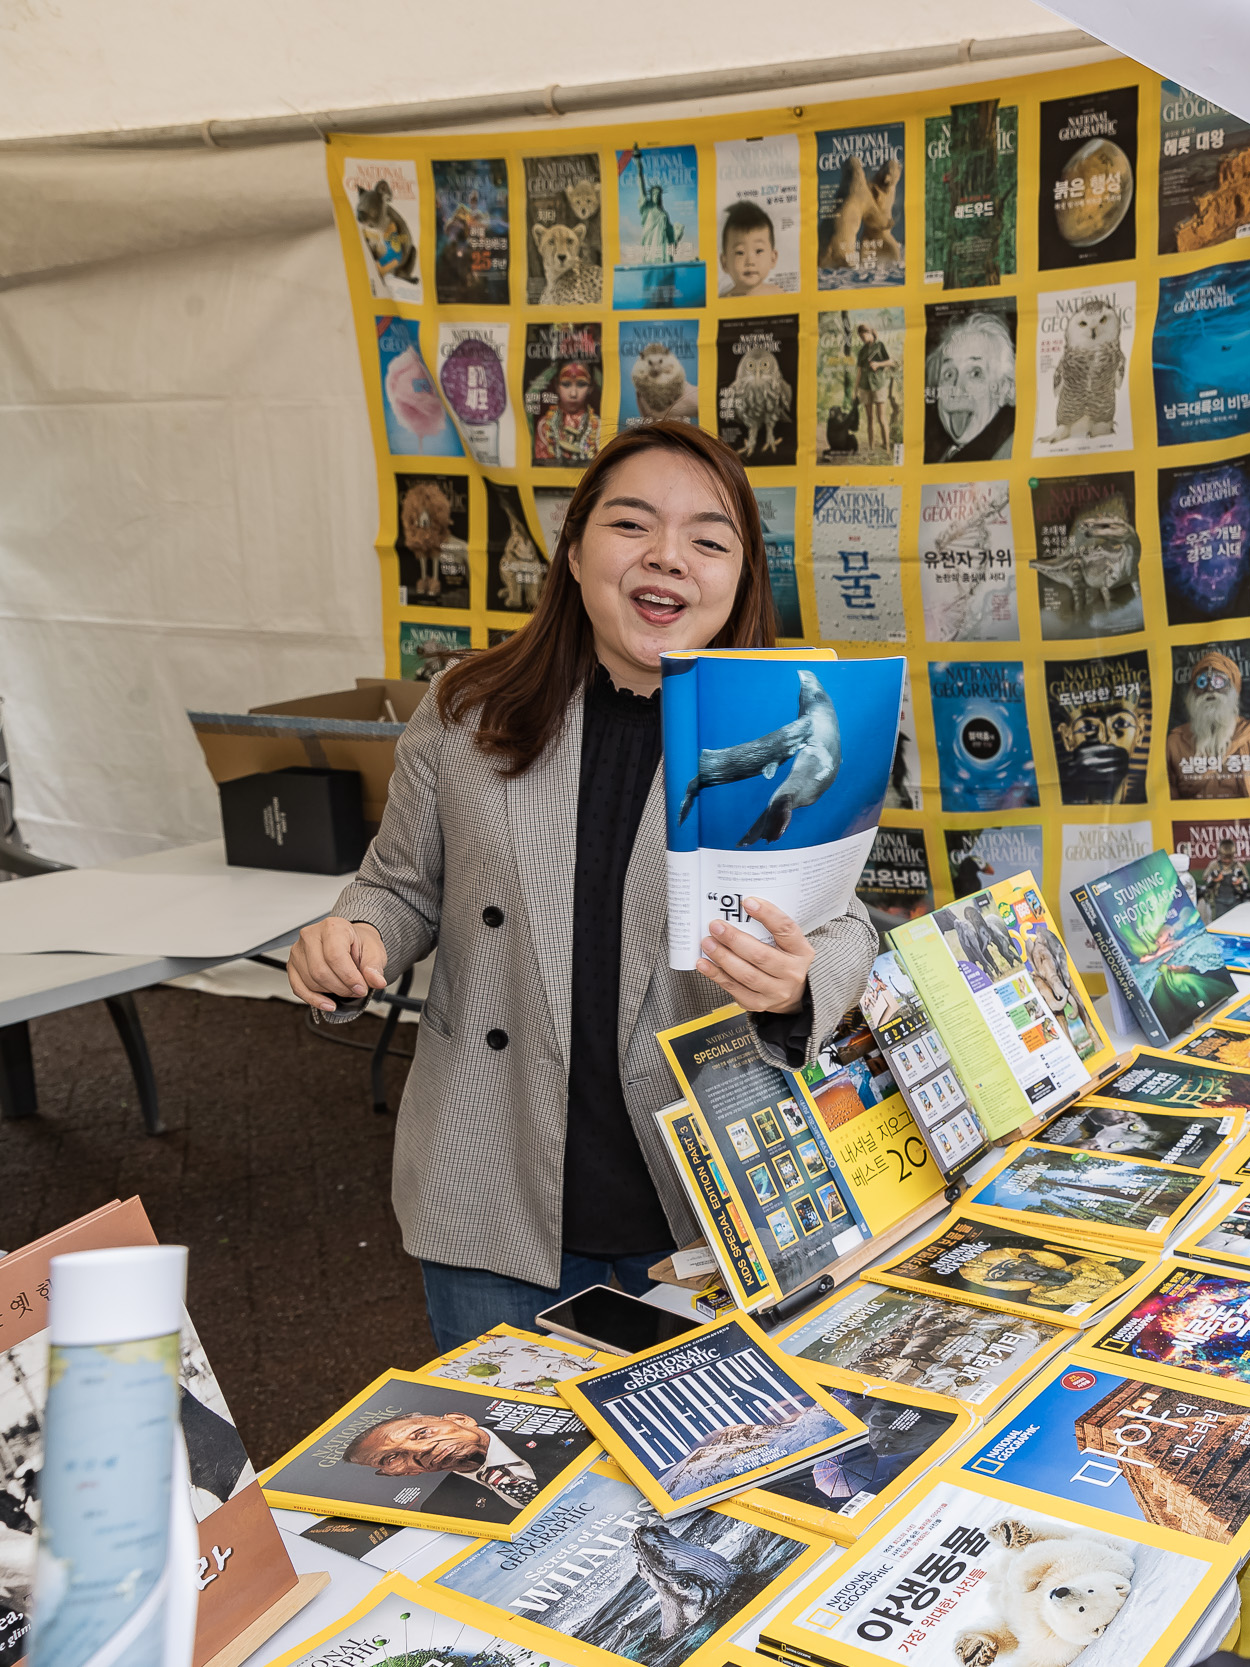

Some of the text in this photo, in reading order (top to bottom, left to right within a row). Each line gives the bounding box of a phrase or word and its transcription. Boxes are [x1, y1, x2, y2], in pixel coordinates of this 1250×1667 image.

[1058, 119, 1118, 142] GEOGRAPHIC
[1068, 111, 1108, 128] NATIONAL
[832, 132, 890, 154] NATIONAL
[1164, 136, 1190, 156] 헤롯
[1196, 128, 1224, 150] 대왕
[1053, 172, 1122, 200] 붉은 행성
[954, 200, 994, 220] 레드우드
[1174, 294, 1238, 314] GEOGRAPHIC
[1184, 284, 1227, 300] NATIONAL
[632, 326, 684, 340] NATIONAL
[1164, 396, 1224, 420] 남극대륙의
[1179, 484, 1241, 508] GEOGRAPHIC
[1188, 478, 1232, 494] NATIONAL
[831, 493, 884, 508] NATIONAL
[816, 508, 898, 526] GEOGRAPHIC
[1186, 524, 1242, 546] 우주 개발
[924, 549, 1012, 569] 유전자 가위
[1186, 542, 1242, 564] 경쟁 시대
[832, 550, 881, 610] 물
[946, 667, 1008, 682] NATIONAL
[1063, 659, 1133, 681] NATIONAL
[933, 681, 1022, 698] GEOGRAPHIC
[1059, 682, 1141, 706] 도난당한 과거
[1178, 755, 1223, 774] 실명의
[962, 829, 1028, 850] NATIONAL
[1078, 829, 1134, 844] NATIONAL
[1065, 842, 1152, 862] GEOGRAPHIC
[863, 869, 928, 888] 구온난화
[1113, 872, 1164, 906] STUNNING
[1112, 884, 1183, 929] PHOTOGRAPHS
[1094, 932, 1134, 1000] PHOTOGRAPHS
[1105, 936, 1135, 988] STUNNING
[693, 1043, 733, 1065] SPECIAL
[840, 1130, 878, 1164] 내셔널
[851, 1135, 927, 1187] 베스트 20
[1119, 1173, 1153, 1196] 살리다
[679, 1125, 754, 1287] KIDS SPECIAL EDITION PART 3
[937, 1222, 974, 1247] 보물들
[930, 1242, 974, 1269] NATIONAL
[936, 1241, 992, 1276] GEOGRAPHIC
[10, 1290, 35, 1319] 옛
[816, 1302, 867, 1336] NATIONAL
[822, 1300, 886, 1344] GEOGRAPHIC
[1112, 1318, 1143, 1340] NATIONAL
[1122, 1314, 1157, 1342] GEOGRAPHIC
[1170, 1305, 1232, 1352] 새로운
[601, 1325, 730, 1381] WE WEREN'T PREPARED FOR THE CORONAVIRUS
[629, 1345, 707, 1381] NATIONAL
[960, 1331, 1030, 1381] 세렝게티
[624, 1349, 721, 1391] GEOGRAPHIC
[485, 1401, 517, 1421] LAST
[494, 1404, 535, 1432] VOICES
[515, 1407, 556, 1435] WORLD
[603, 1348, 807, 1471] EVEREST
[312, 1409, 382, 1459] NATIONAL
[536, 1415, 569, 1435] WAR
[1171, 1409, 1227, 1458] 미스터리
[736, 1444, 769, 1462] JOURNEY
[746, 1454, 759, 1463] THE
[759, 1445, 780, 1458] ROOF
[986, 1429, 1024, 1459] NATIONAL
[997, 1424, 1042, 1462] GEOGRAPHIC
[733, 1466, 744, 1475] OF
[745, 1459, 761, 1470] THE
[760, 1448, 788, 1464] WORLD
[496, 1504, 575, 1558] NATIONAL
[499, 1502, 595, 1572] GEOGRAPHIC
[533, 1521, 586, 1560] THE OCEAN ISSUE
[524, 1513, 618, 1582] Secrets of the
[826, 1569, 873, 1609] NATIONAL
[837, 1563, 894, 1612] GEOGRAPHIC
[856, 1526, 991, 1642] 야생동물
[897, 1568, 988, 1653] 가장 위대한 사진들
